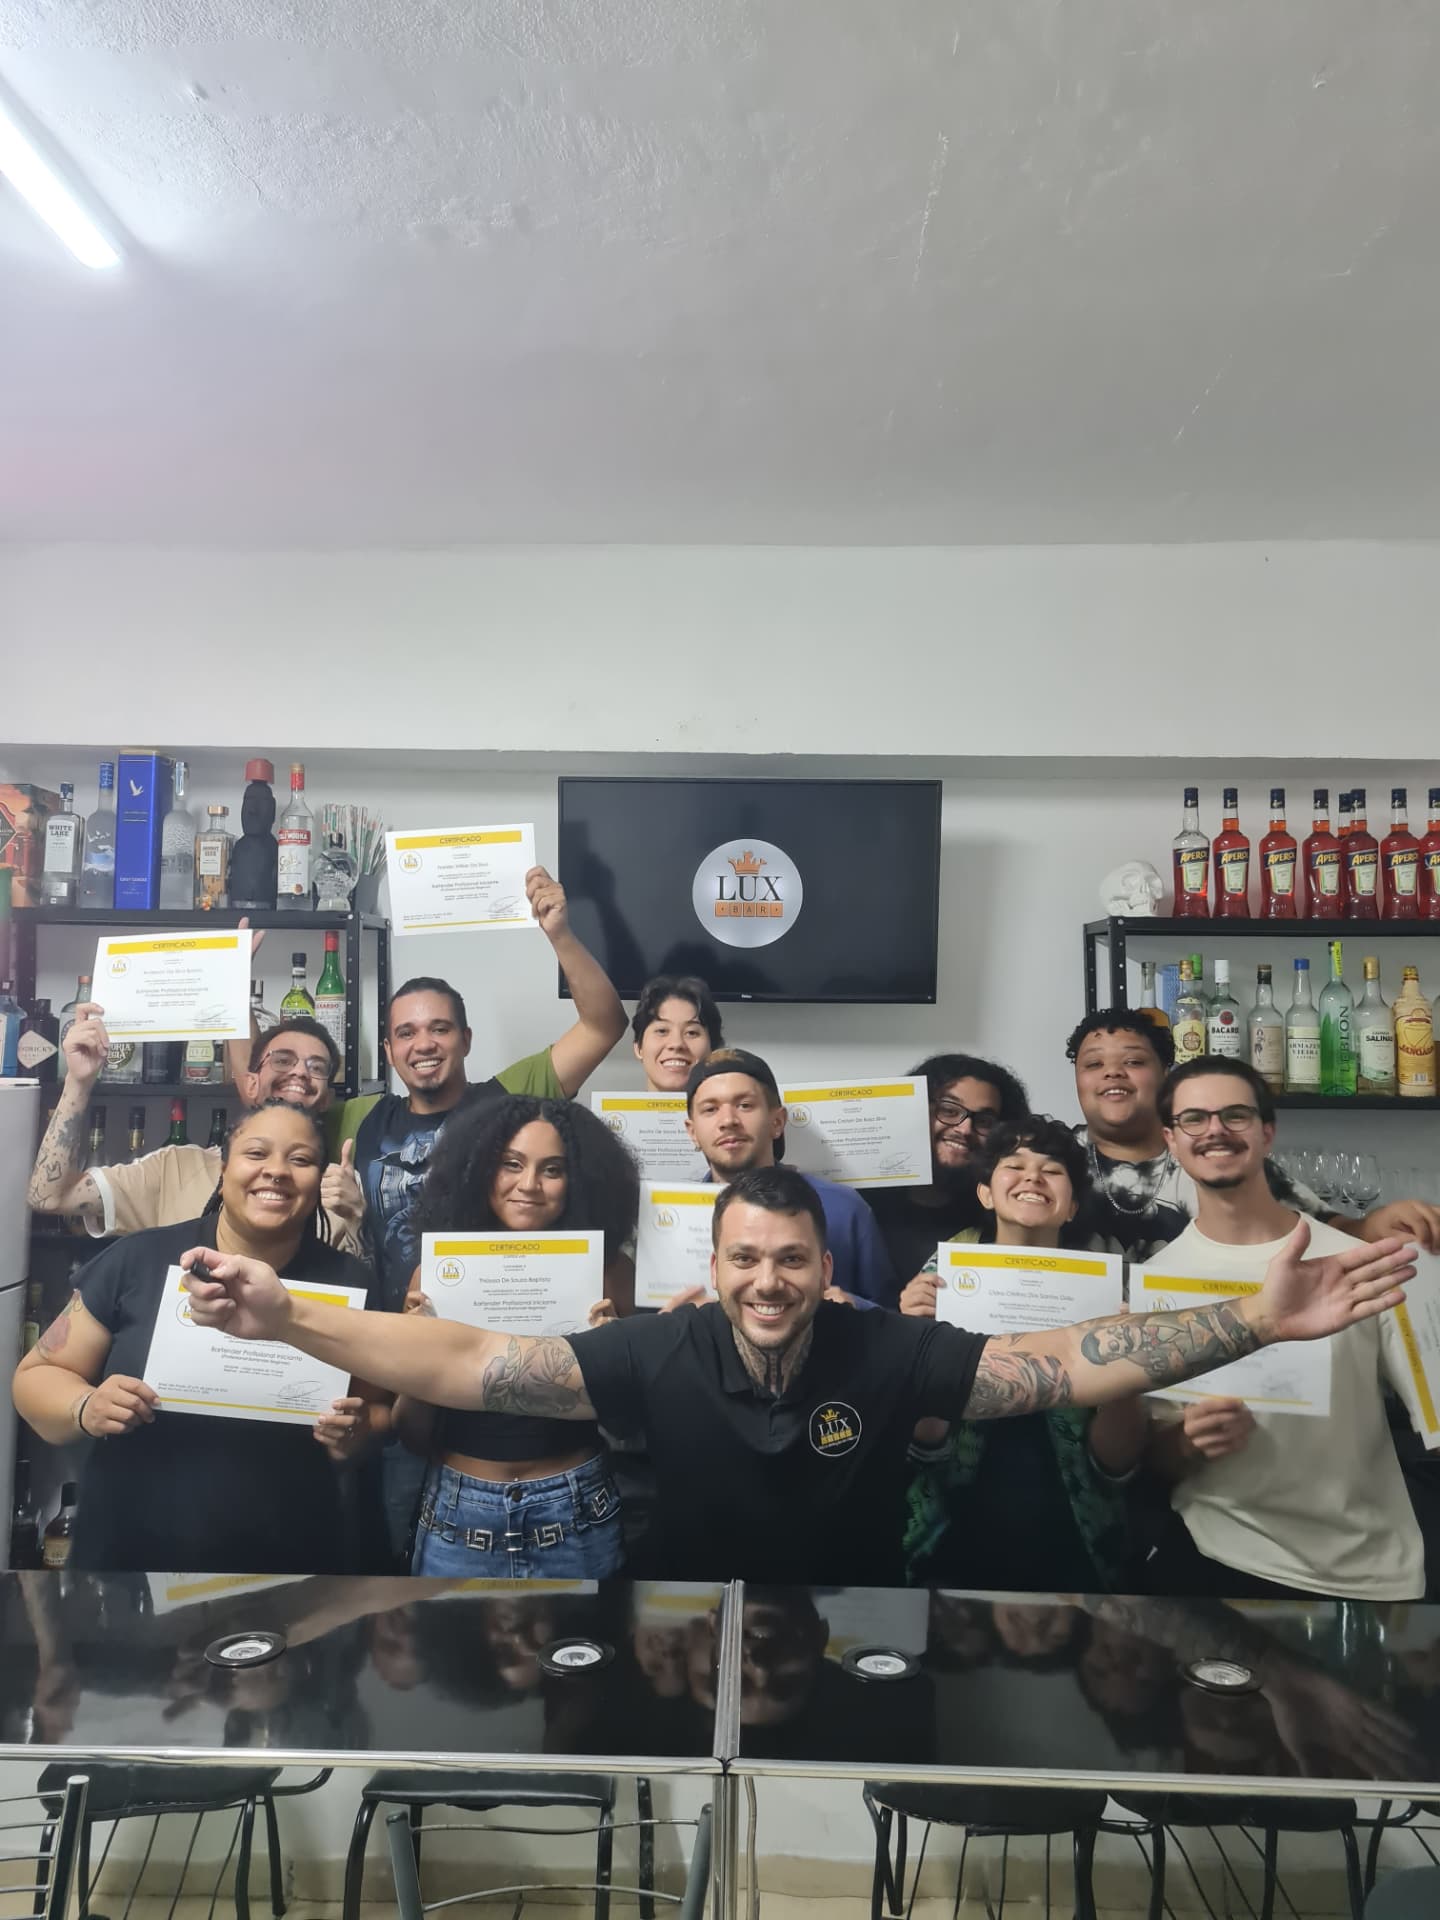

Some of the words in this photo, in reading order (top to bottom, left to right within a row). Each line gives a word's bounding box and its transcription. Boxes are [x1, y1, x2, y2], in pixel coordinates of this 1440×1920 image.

[716, 875, 784, 902] LUX
[1339, 1006, 1350, 1073] LEBLON
[829, 1089, 873, 1097] CERTIFICADO
[489, 1243, 540, 1252] CERTIFICADO
[1004, 1257, 1057, 1268] CERTIFICADO
[817, 1417, 849, 1437] LUX
